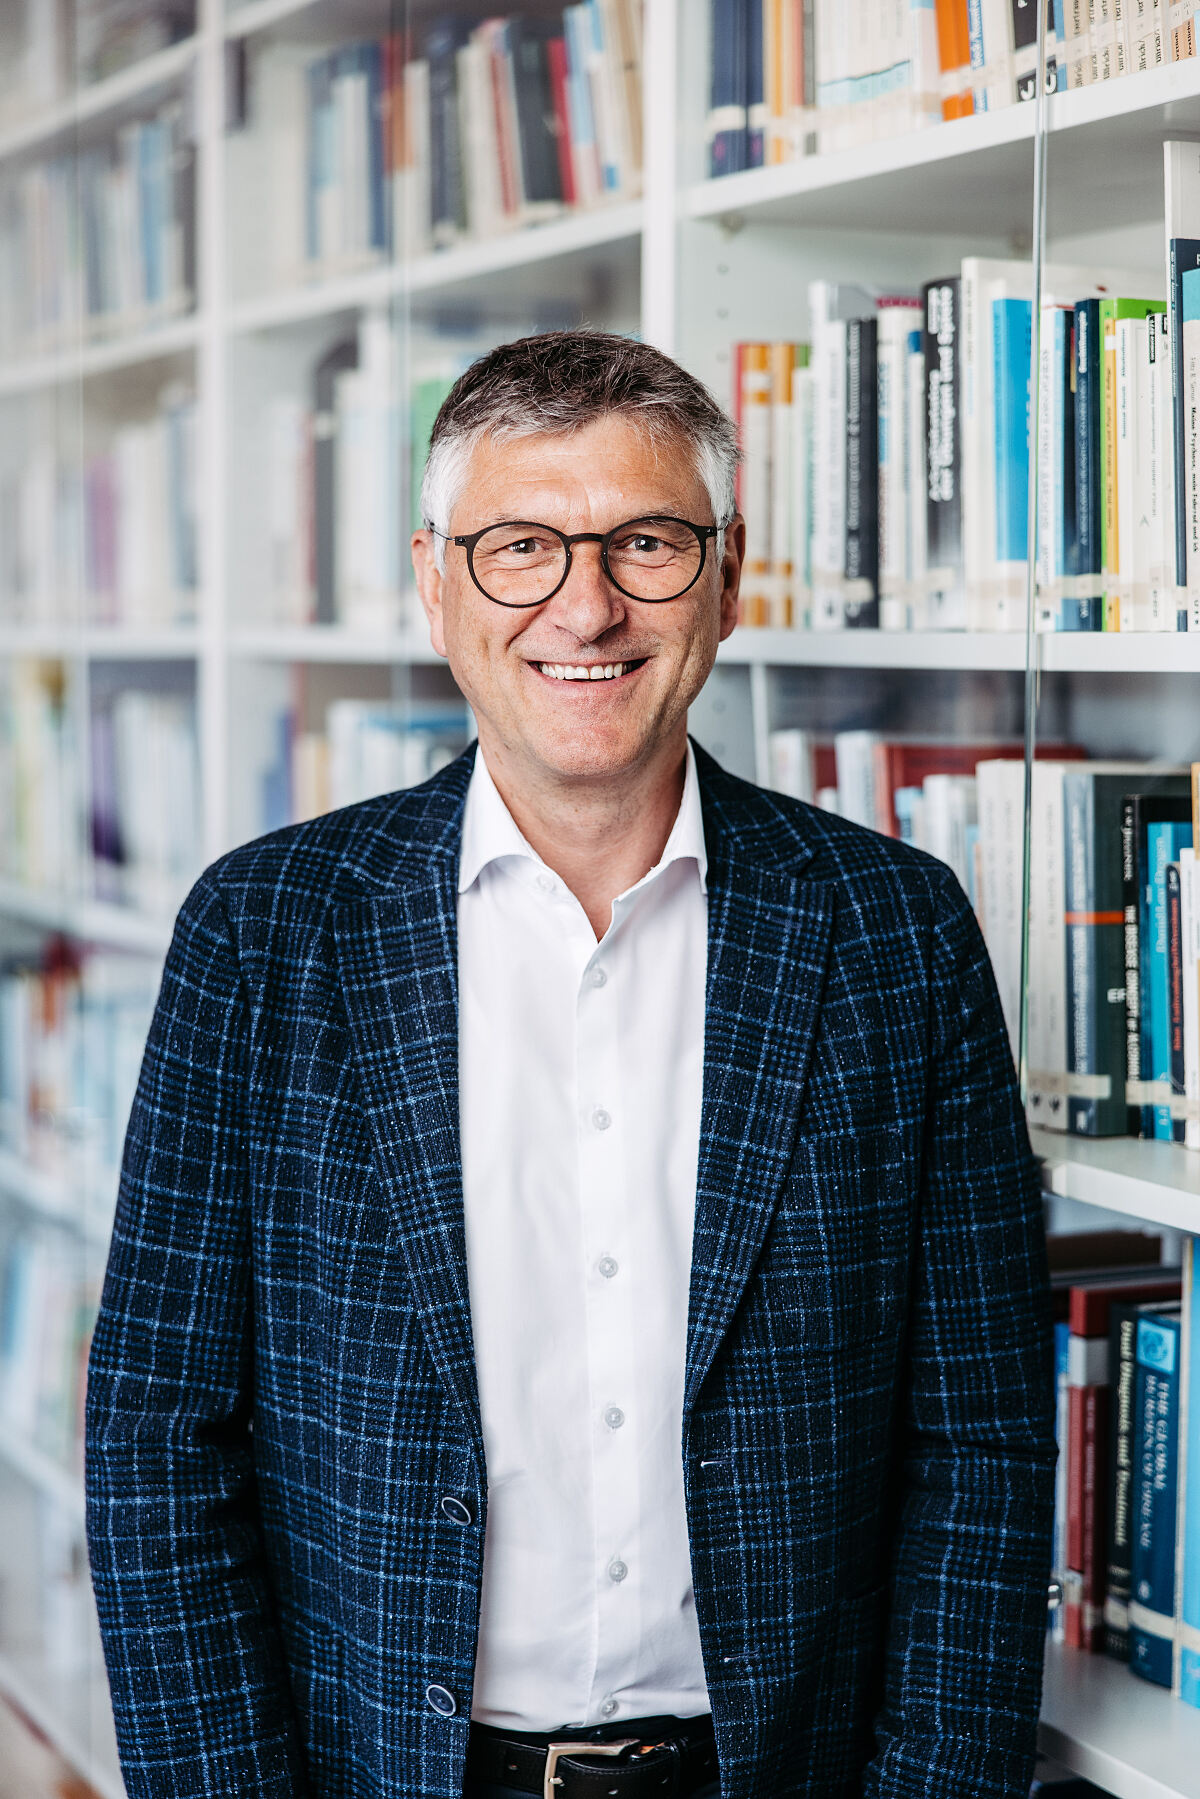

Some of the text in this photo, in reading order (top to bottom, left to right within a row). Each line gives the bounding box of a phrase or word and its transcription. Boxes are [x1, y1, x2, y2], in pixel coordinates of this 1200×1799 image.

[1124, 904, 1137, 924] THE
[1124, 924, 1139, 968] DISEASE
[1125, 969, 1139, 1017] CONCEPT
